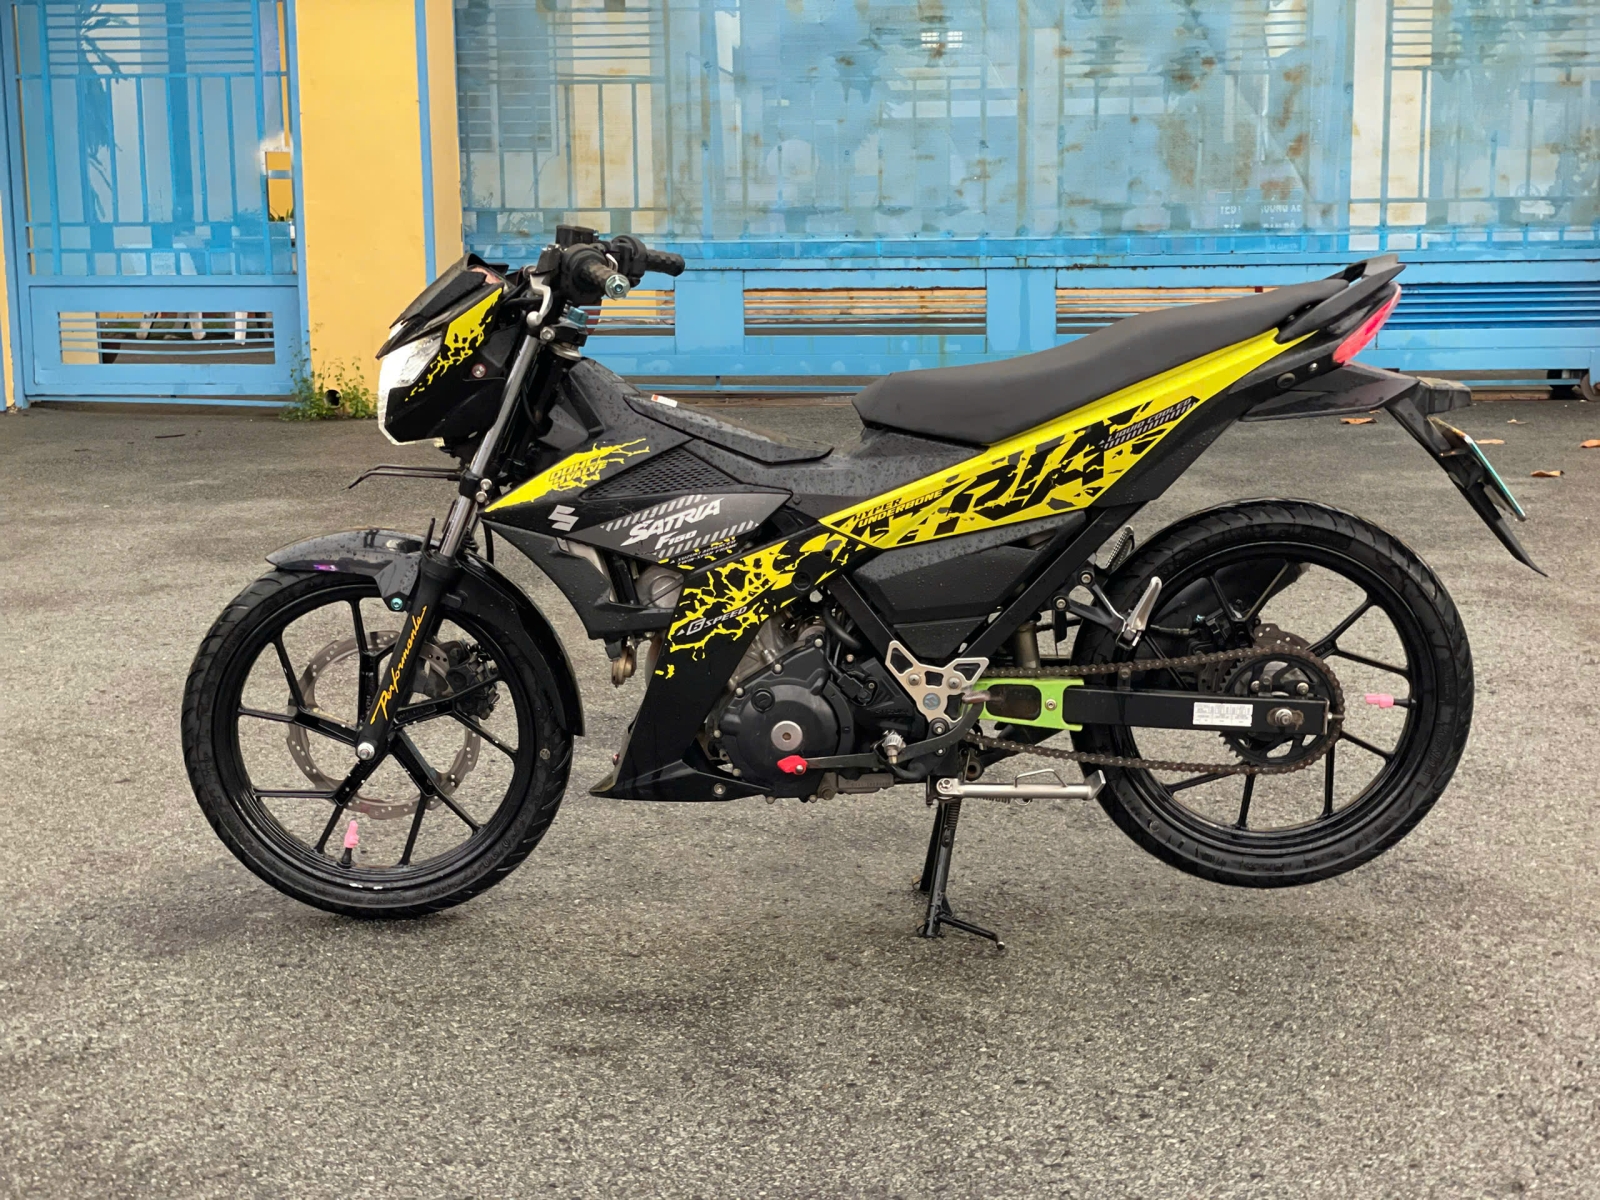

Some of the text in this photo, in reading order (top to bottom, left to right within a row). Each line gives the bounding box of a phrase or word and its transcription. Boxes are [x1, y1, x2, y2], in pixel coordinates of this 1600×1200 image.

[1107, 397, 1192, 442] LIQUID COOLED
[620, 497, 725, 546] SATRIA
[853, 498, 902, 521] HYPER
[858, 489, 943, 528] UNDERBONE
[704, 606, 748, 628] SPEED
